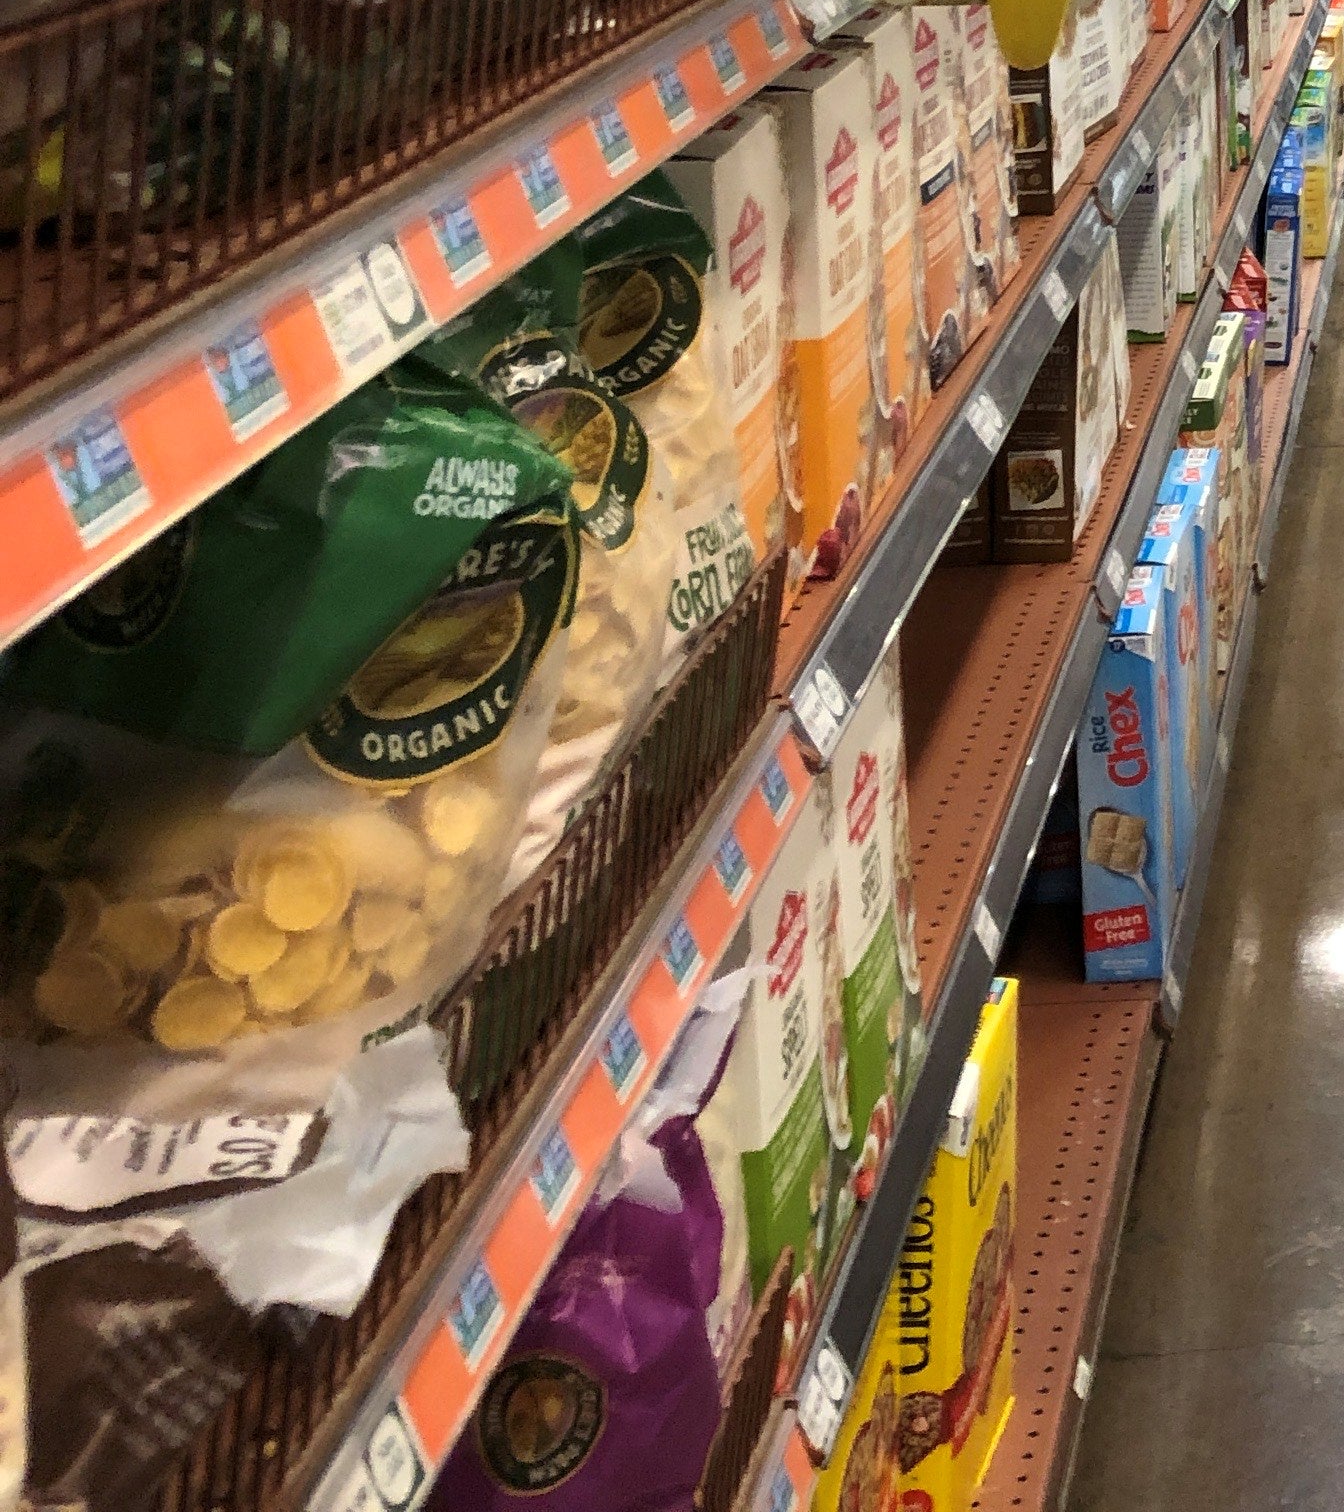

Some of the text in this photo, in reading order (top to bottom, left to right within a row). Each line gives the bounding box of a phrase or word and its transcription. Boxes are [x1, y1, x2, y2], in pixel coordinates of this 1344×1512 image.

[424, 456, 521, 497] ALWAYS
[360, 682, 513, 763] ORGANIC
[1091, 714, 1110, 754] Rice
[1104, 686, 1149, 787] Chex
[1094, 913, 1143, 933] Gluten
[1105, 928, 1135, 943] Free
